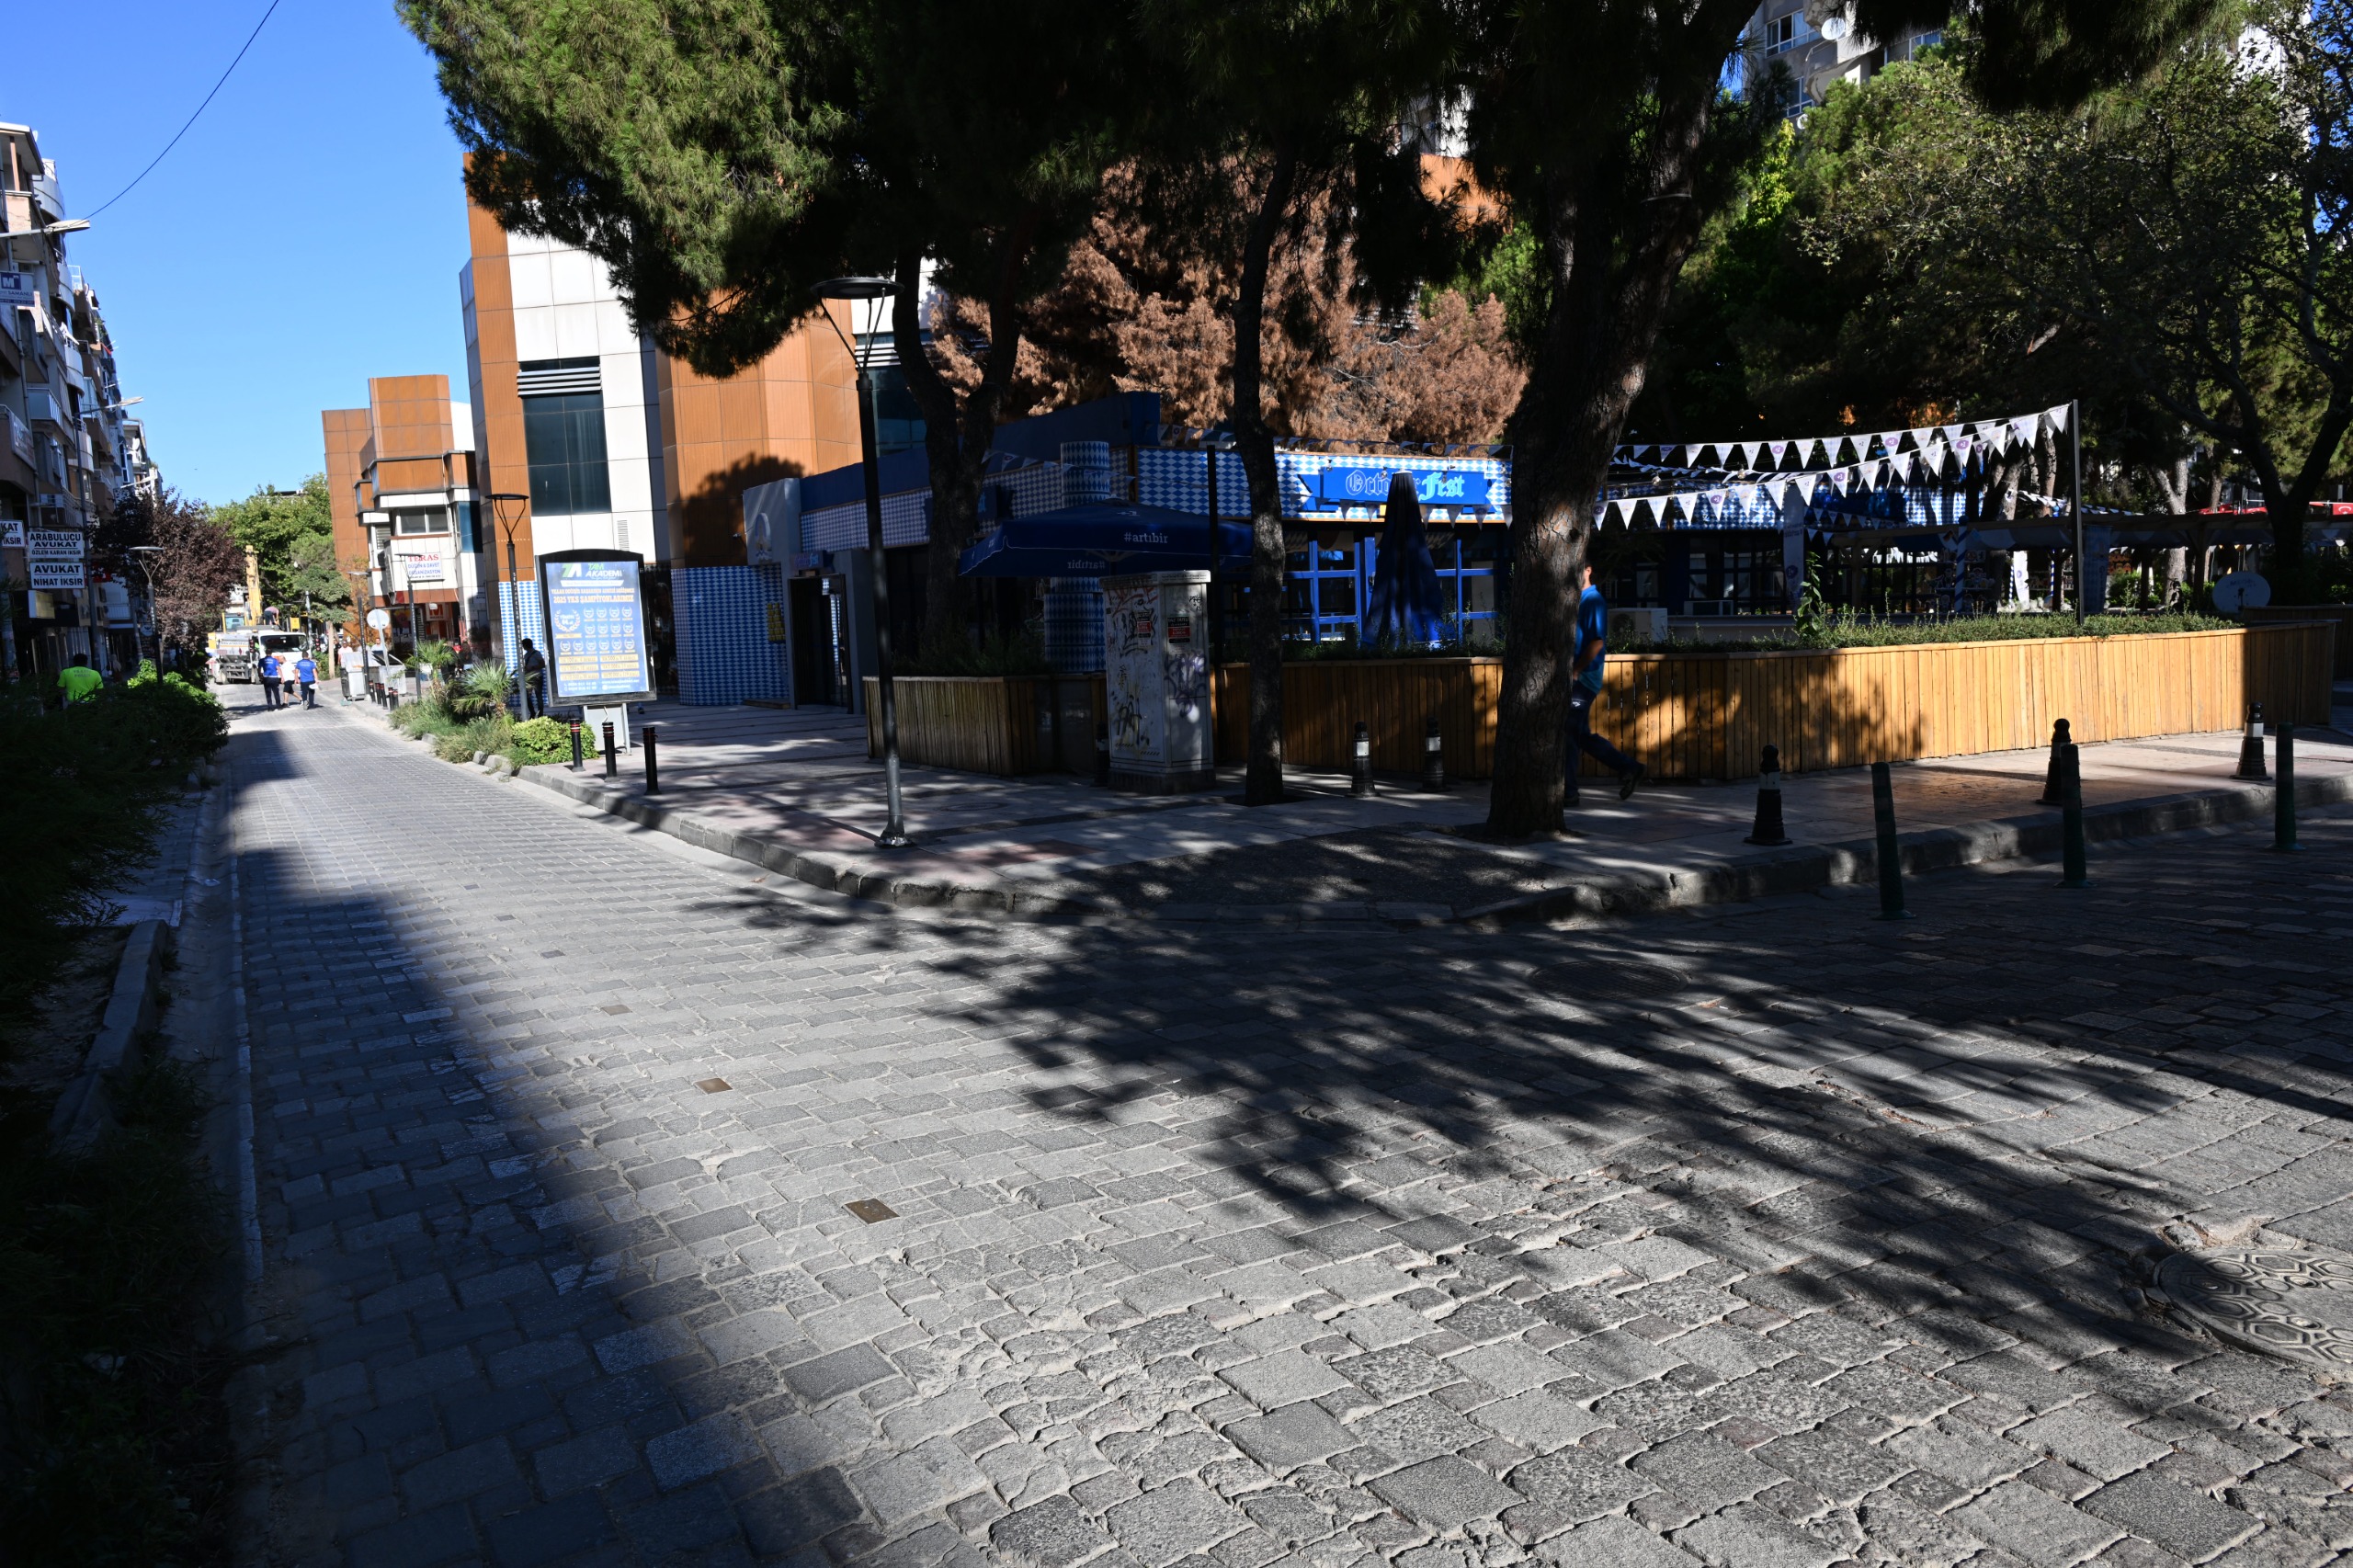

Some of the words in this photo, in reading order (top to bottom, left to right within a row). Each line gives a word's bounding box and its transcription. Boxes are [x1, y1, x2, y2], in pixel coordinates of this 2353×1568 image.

[1346, 470, 1465, 501] OctorFest
[30, 533, 81, 541] ARABULUCU
[407, 553, 439, 562] TERAS
[34, 565, 80, 574] AVUKAT
[33, 576, 58, 585] NİHAT
[61, 576, 83, 585] İKSİR
